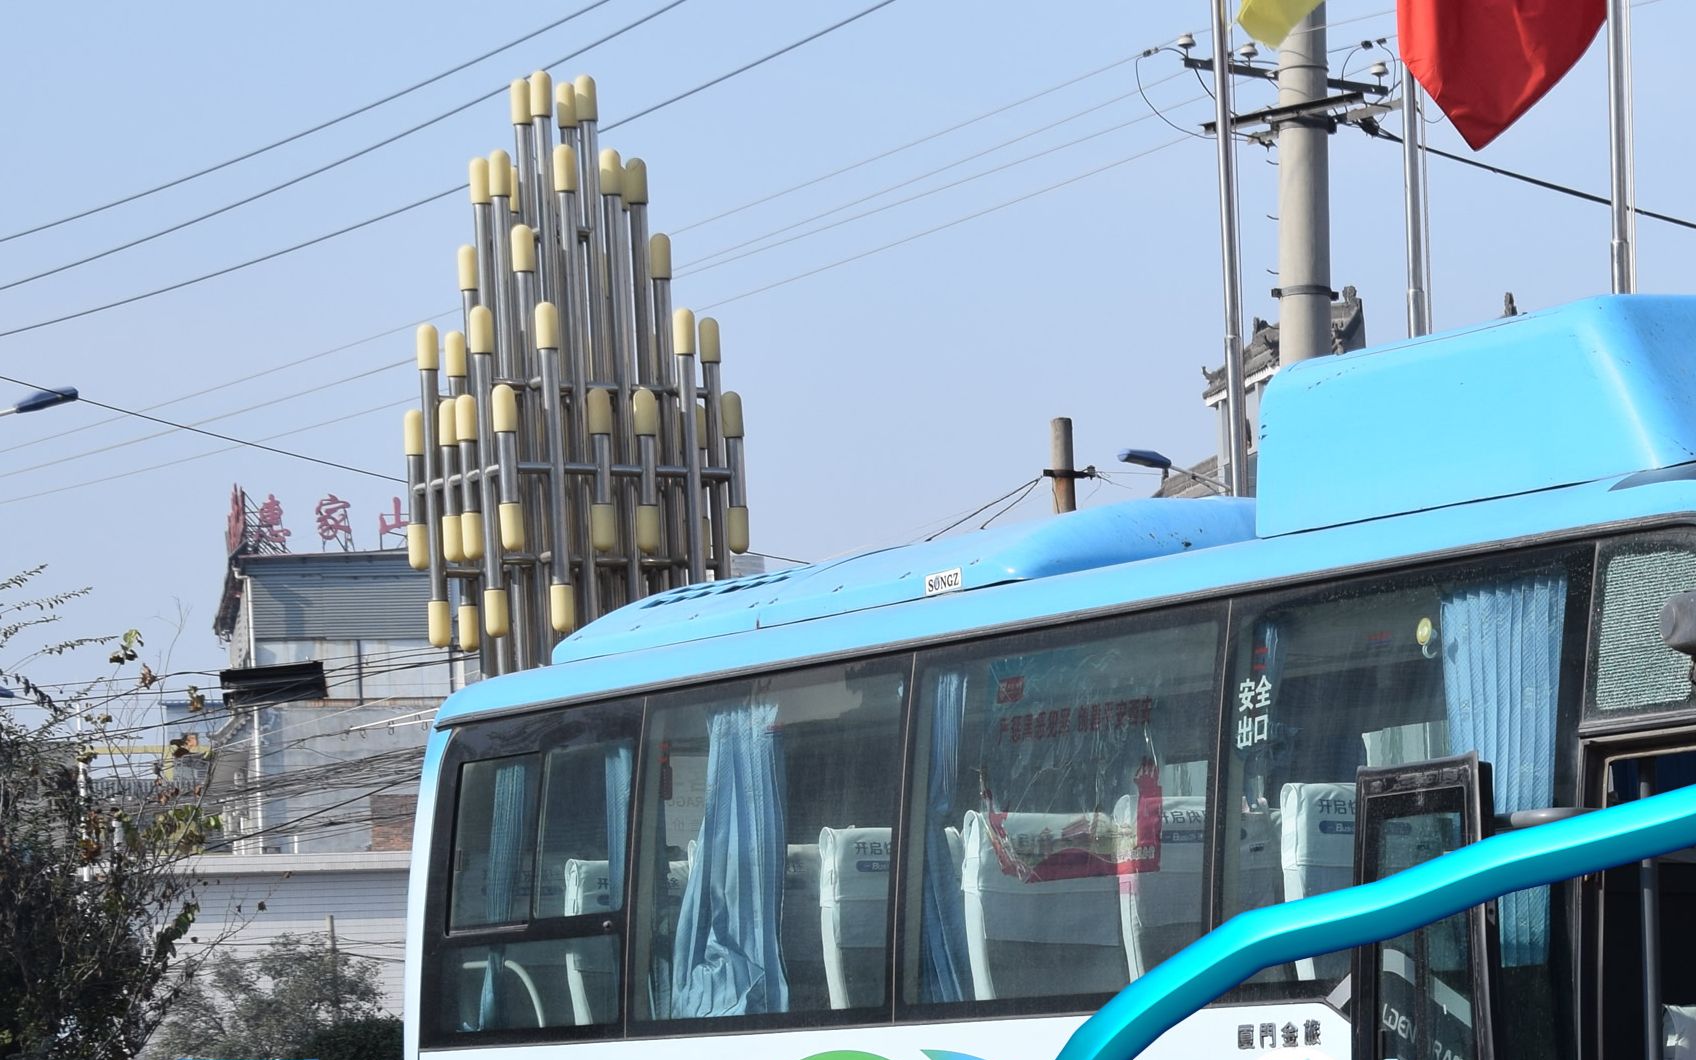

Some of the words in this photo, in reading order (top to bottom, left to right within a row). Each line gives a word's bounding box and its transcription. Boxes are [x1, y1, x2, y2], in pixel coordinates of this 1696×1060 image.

[927, 572, 960, 593] SONGZ
[1238, 675, 1272, 712] 安全
[1236, 714, 1269, 749] 出口
